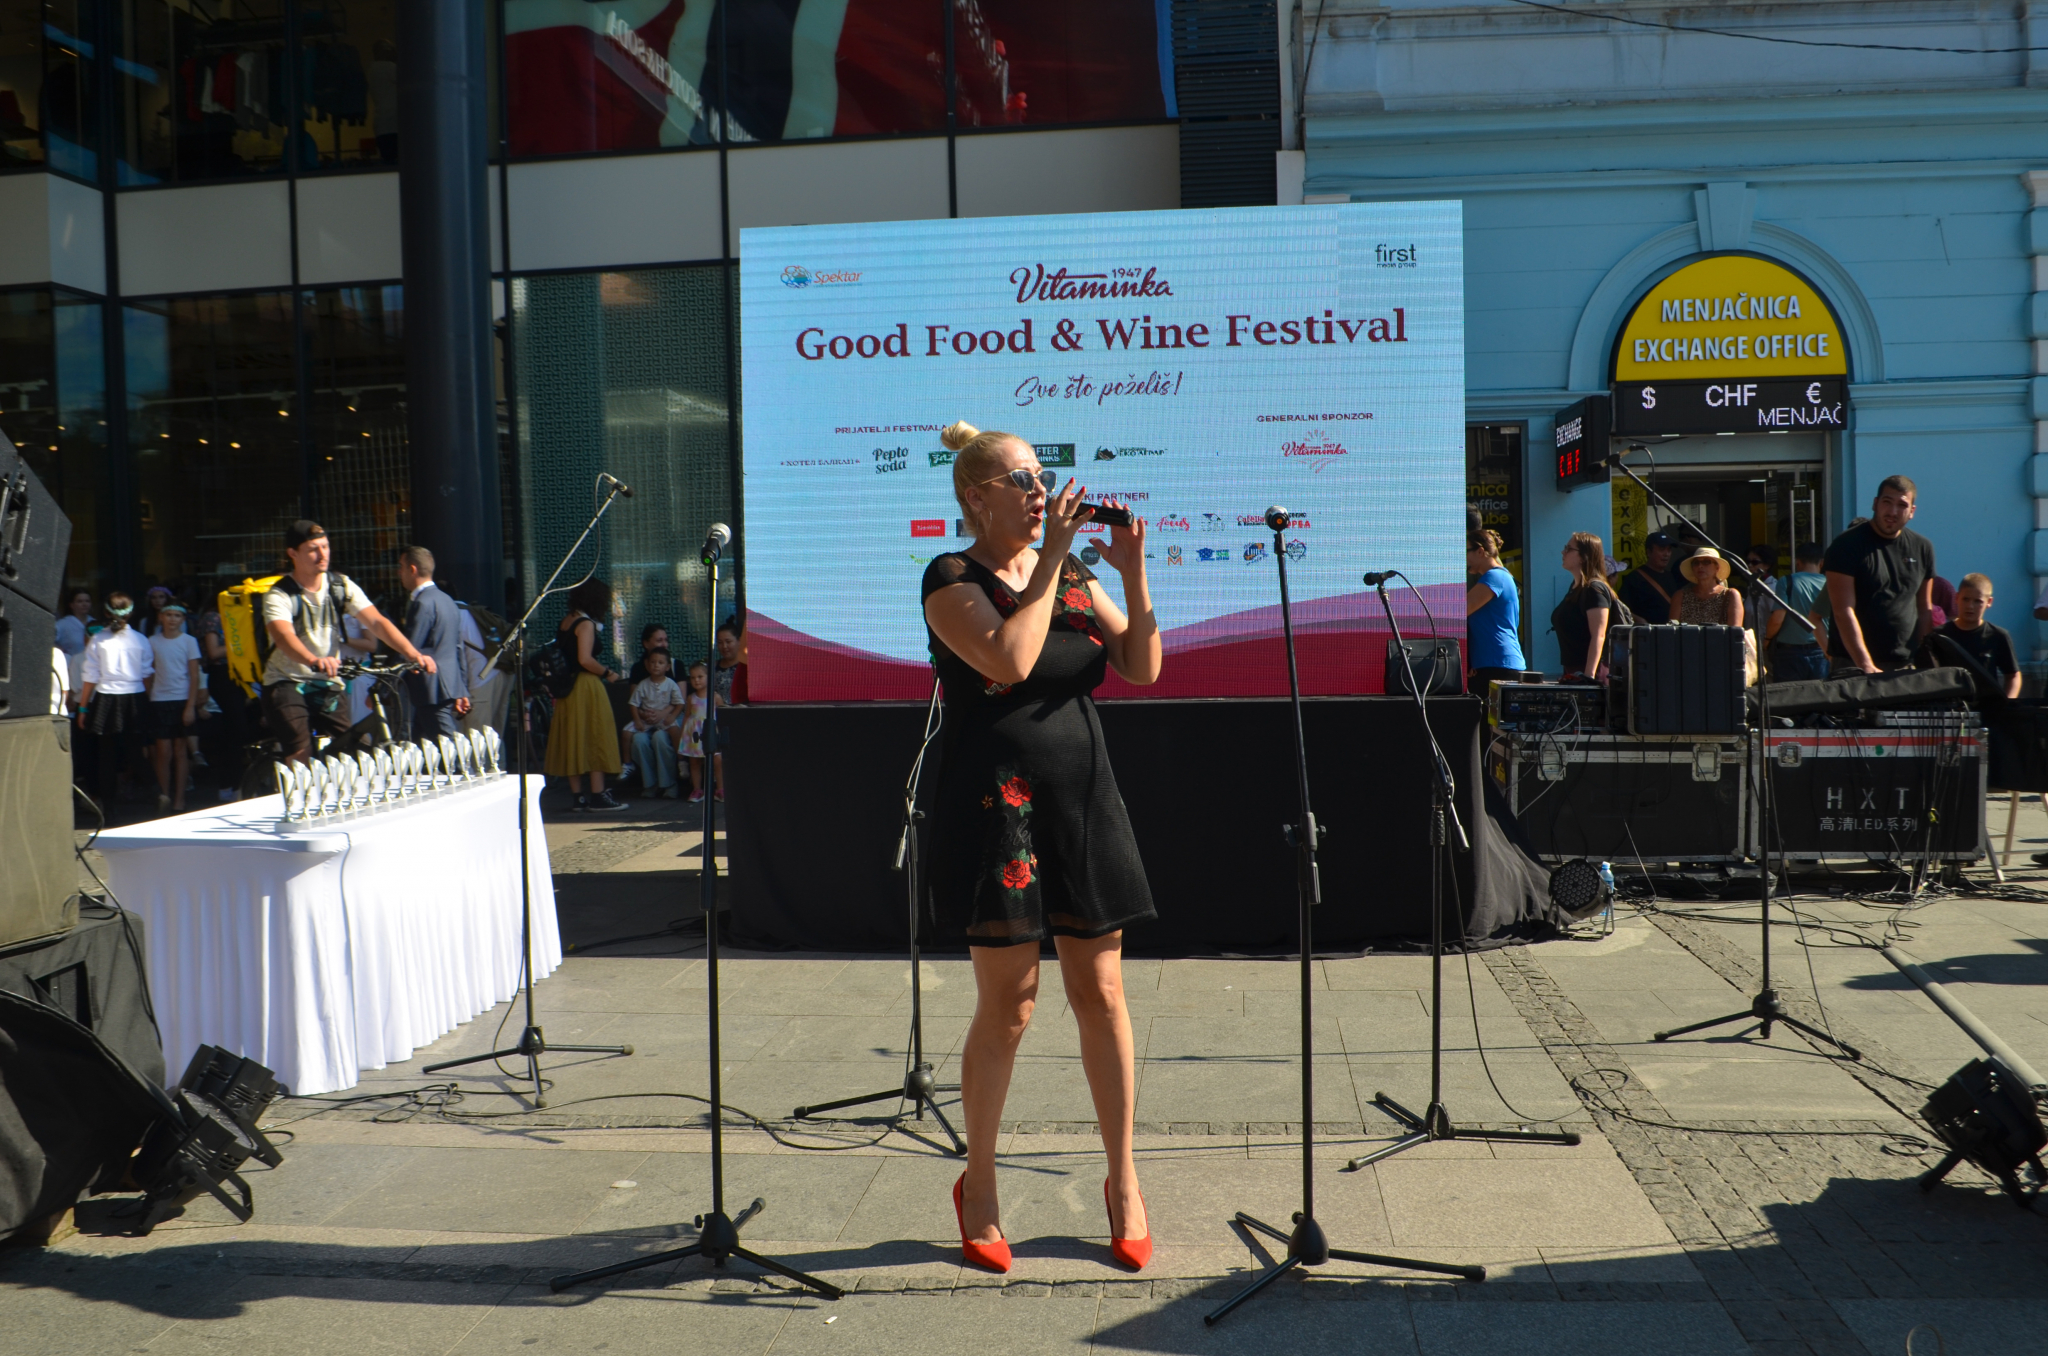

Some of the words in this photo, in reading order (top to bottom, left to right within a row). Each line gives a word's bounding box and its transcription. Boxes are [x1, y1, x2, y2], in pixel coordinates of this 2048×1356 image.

[1375, 243, 1416, 262] first
[814, 269, 863, 285] Spektar
[1112, 267, 1142, 279] 1947
[1009, 263, 1174, 304] Vitaminka
[1661, 292, 1801, 323] MENJAČNICA
[796, 323, 911, 360] Good
[925, 319, 1036, 355] Food
[1050, 318, 1084, 351] &
[1096, 314, 1210, 350] Wine
[1225, 307, 1408, 346] Festival
[1634, 336, 1749, 363] EXCHANGE
[1754, 333, 1829, 359] OFFICE
[1015, 376, 1058, 406] Sve
[1064, 374, 1097, 399] što
[1098, 370, 1183, 405] poželiš!
[1641, 386, 1656, 409] $
[1705, 384, 1758, 407] CHF
[1805, 382, 1822, 404] €
[1257, 414, 1319, 422] GENERALNI
[1322, 412, 1374, 421] SPONZOR
[835, 426, 891, 434] PRIJATELJI
[872, 446, 909, 461] Pepto
[1281, 441, 1349, 457] Vitaminka
[875, 460, 907, 474] soda
[1559, 449, 1580, 478] CHF
[1097, 492, 1149, 502] PARTNERI
[1481, 513, 1509, 525] ube
